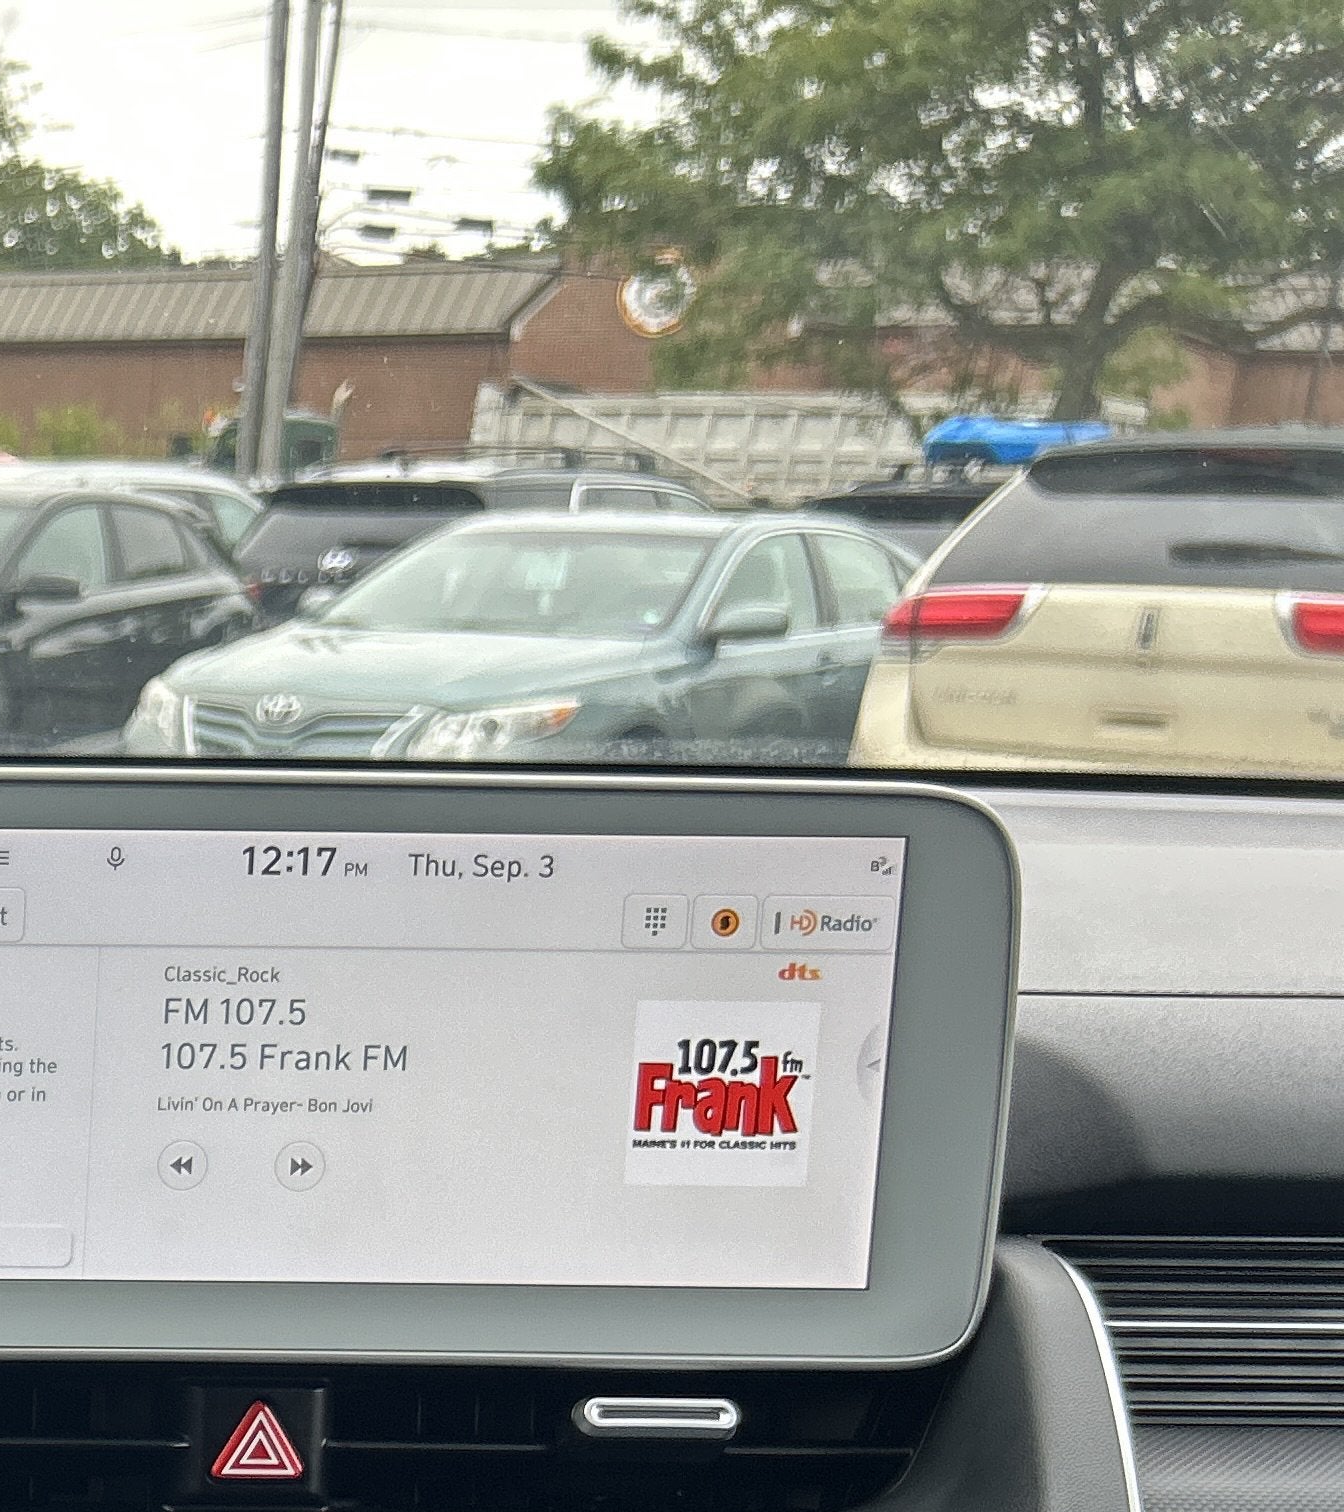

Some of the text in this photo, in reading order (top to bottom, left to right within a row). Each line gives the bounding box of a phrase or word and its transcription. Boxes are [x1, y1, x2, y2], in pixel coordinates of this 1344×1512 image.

[242, 845, 555, 882] 12:17 PM Thu, Sep. 3
[164, 965, 280, 985] Classic_Rock
[778, 962, 823, 982] dts
[163, 998, 307, 1027] FM 107.5
[29, 1059, 58, 1074] the
[160, 1042, 408, 1072] 107.5 Frank FM
[677, 1038, 760, 1076] 107.5
[782, 1051, 804, 1073] fm
[6, 1088, 26, 1102] or
[31, 1087, 46, 1102] in
[634, 1056, 799, 1136] Frank
[157, 1096, 373, 1116] Livin' On A Prayer- Bon Jovi
[693, 1139, 716, 1150] FOR
[719, 1139, 765, 1150] CLASSIC
[770, 1140, 797, 1150] HITS
